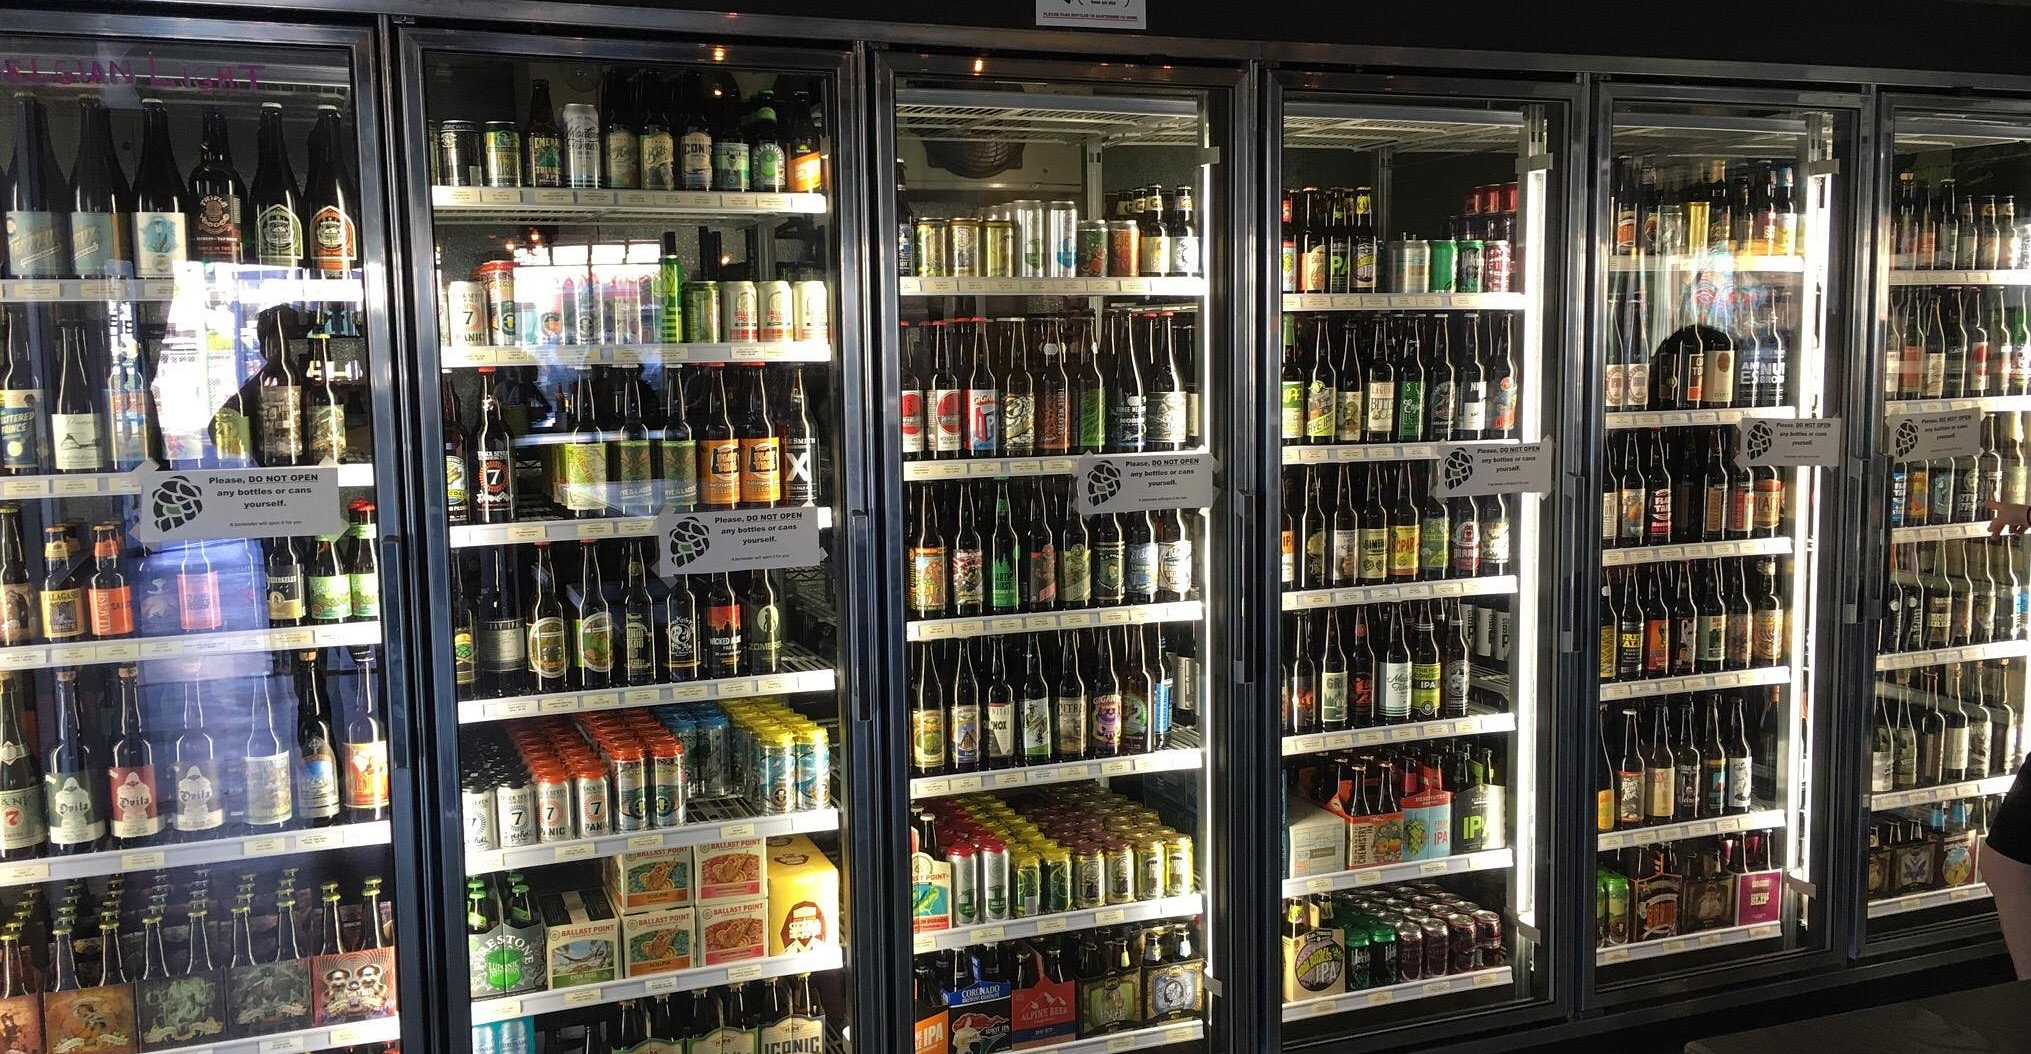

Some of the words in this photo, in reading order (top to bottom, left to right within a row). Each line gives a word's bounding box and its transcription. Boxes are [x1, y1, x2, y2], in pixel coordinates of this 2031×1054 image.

[4, 58, 133, 85] ELGIAN
[464, 312, 474, 324] 7
[786, 453, 810, 482] X
[208, 476, 245, 484] Please,
[488, 470, 500, 485] 7
[217, 489, 234, 498] any
[238, 487, 272, 496] bottles
[244, 500, 286, 510] yourself.
[714, 516, 744, 524] Please,
[742, 536, 776, 546] yourself.
[1420, 680, 1436, 688] IPA
[547, 807, 555, 820] 7
[590, 802, 602, 814] 7
[6, 810, 20, 826] 7
[512, 812, 522, 826] 7
[1464, 815, 1488, 840] IPA
[710, 841, 739, 850] BALLAST
[741, 838, 760, 848] POINT
[1358, 826, 1367, 864] CHEMISTRY
[1434, 832, 1448, 846] IPA
[636, 848, 666, 858] BALLAST
[666, 846, 688, 854] POINT
[714, 906, 742, 916] BALLAST
[743, 902, 763, 912] POINT
[638, 916, 668, 926] BALLAST
[669, 913, 690, 922] POINT
[562, 927, 592, 937] BALLAST
[594, 924, 614, 932] POINT
[962, 985, 1000, 998] CORONADO
[1022, 1009, 1048, 1022] ALPINE
[1050, 1007, 1068, 1016] BEER
[924, 1022, 944, 1046] IPA
[764, 1036, 820, 1054] ICONIC
